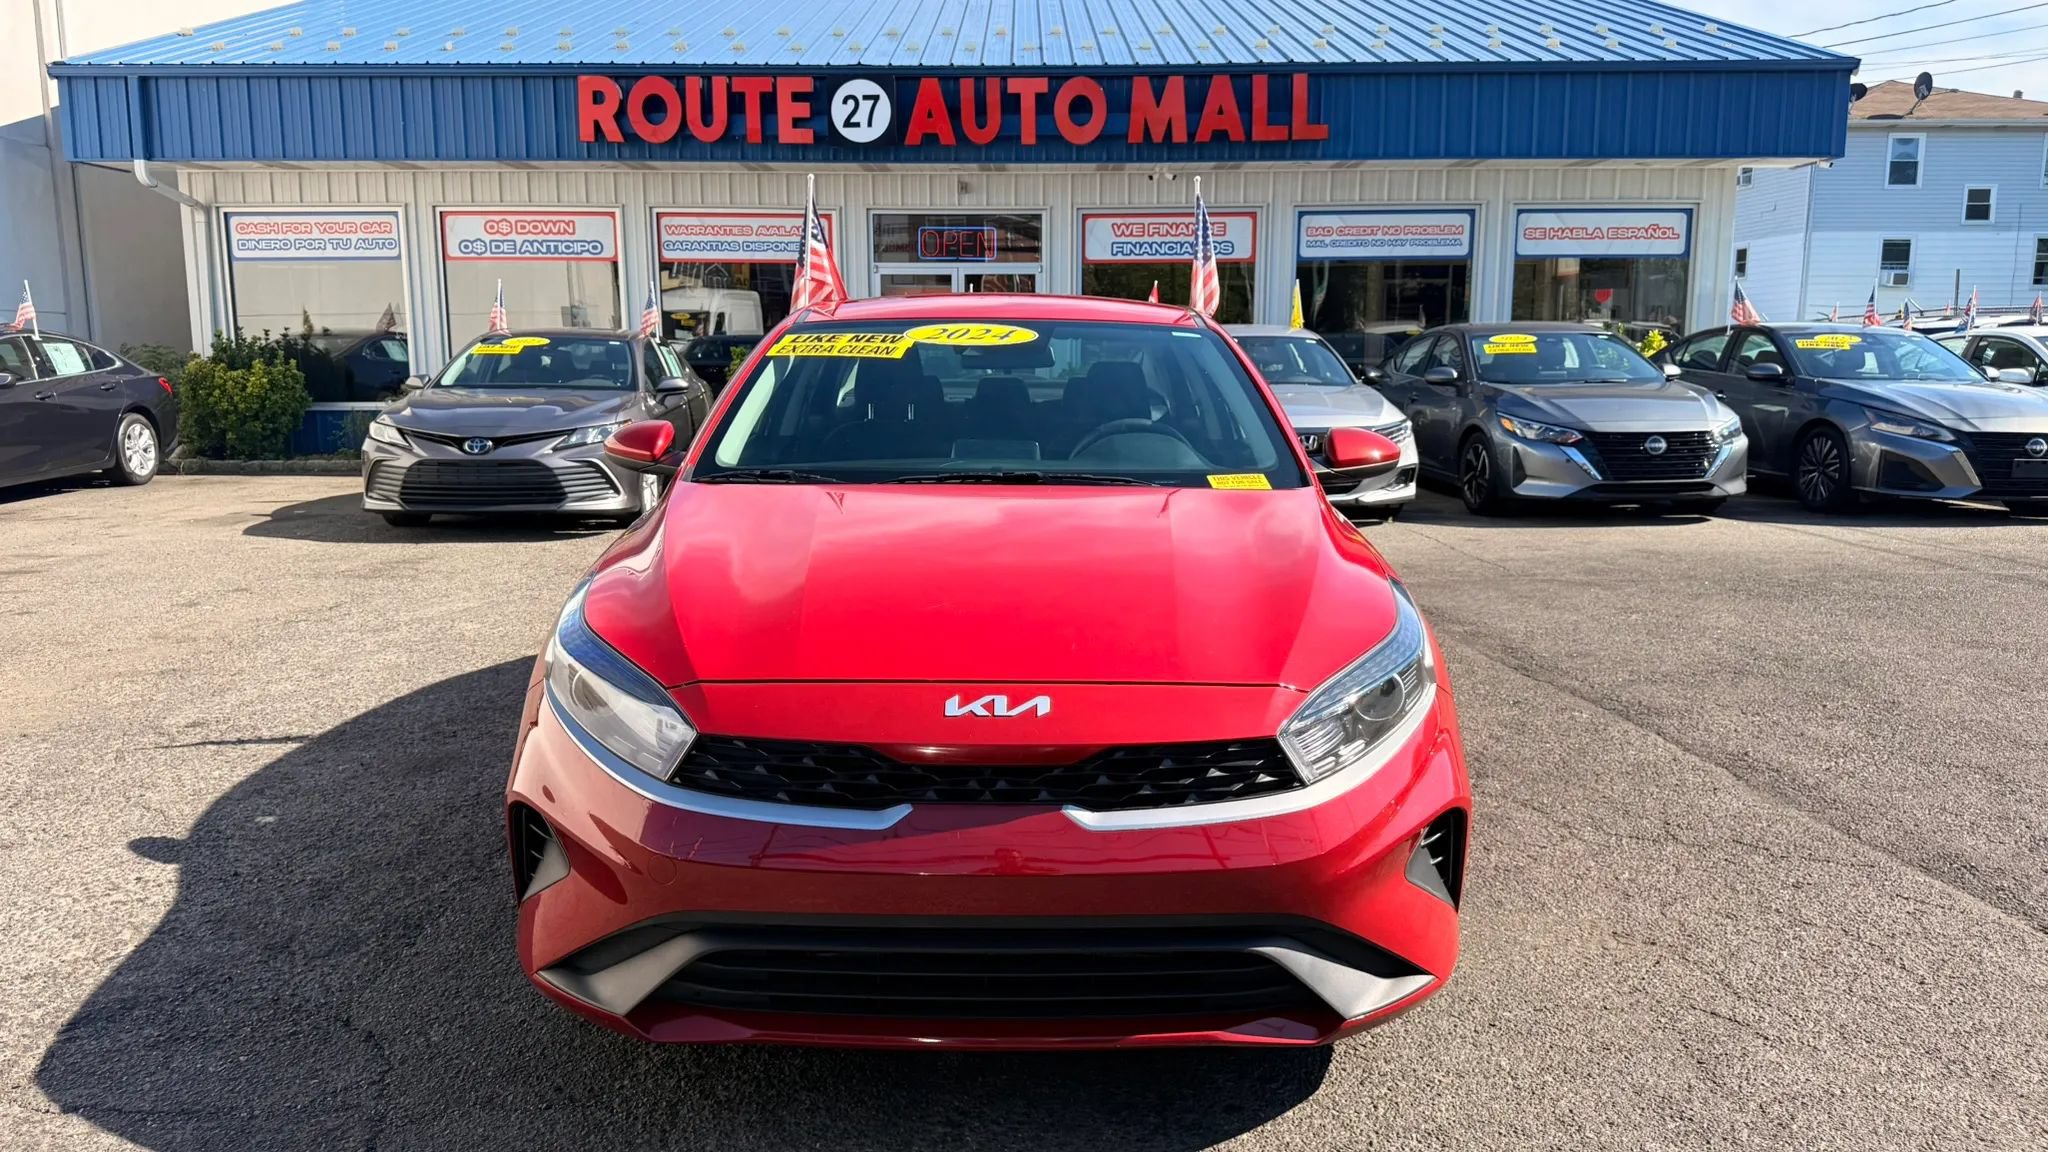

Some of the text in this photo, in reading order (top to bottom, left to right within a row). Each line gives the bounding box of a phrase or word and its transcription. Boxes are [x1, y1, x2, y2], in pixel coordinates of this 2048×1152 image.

[578, 73, 1329, 146] ROUTE 27 AUTO MALL
[236, 221, 392, 234] CASH FOR YOUR CAR
[515, 220, 576, 235] DOWN
[665, 224, 803, 237] WARRANTIES AVAILA
[1112, 222, 1145, 237] WE
[1306, 224, 1464, 237] BAD CREDIT NO PROBLEM
[1524, 223, 1680, 241] SE HABLA ESPAÑOL
[238, 238, 398, 251] DINERO POR TU AUTO
[489, 240, 516, 255] DE
[519, 240, 603, 255] ANTICIPO
[663, 240, 744, 252] GARANTIAS
[921, 229, 995, 257] OPEN
[1306, 240, 1328, 248] MAL
[1371, 239, 1386, 248] NO
[1387, 239, 1408, 247] HAY
[1409, 238, 1463, 247] PROBLEMA
[791, 334, 905, 344] LIKE NEW
[928, 328, 1017, 341] 2024
[776, 344, 898, 356] EXTRA CLEAN
[944, 694, 1051, 717] KIA
